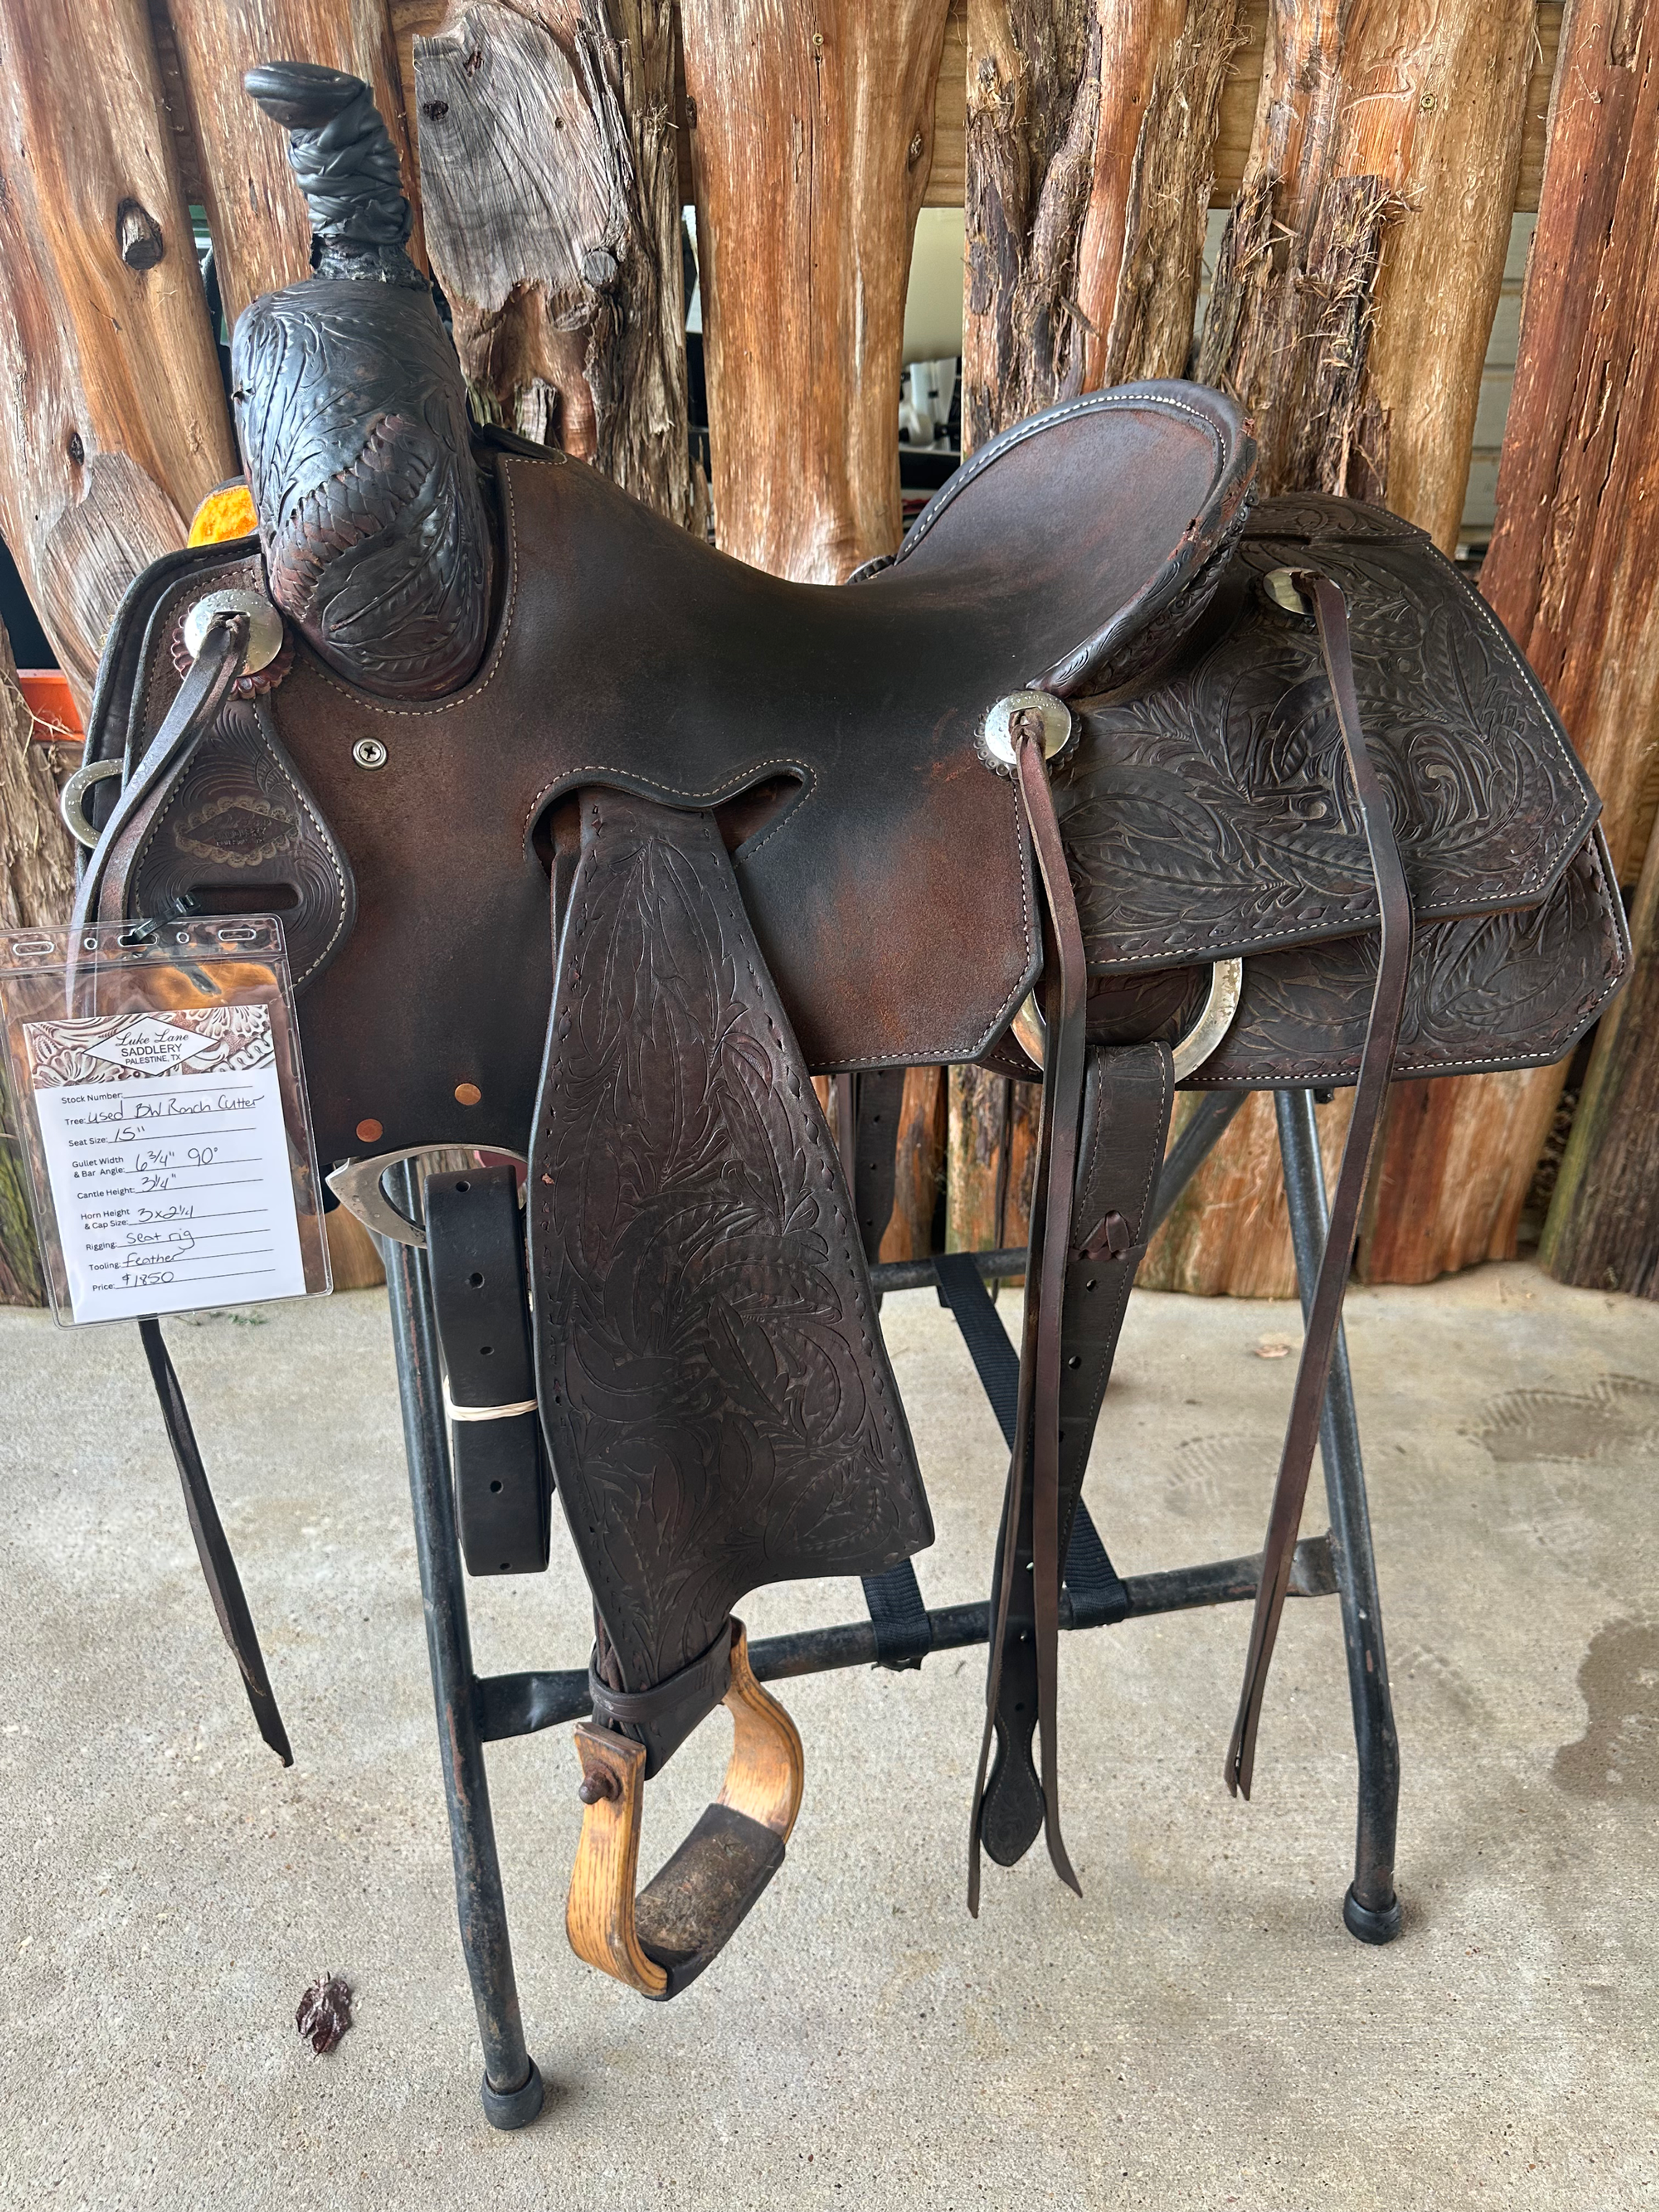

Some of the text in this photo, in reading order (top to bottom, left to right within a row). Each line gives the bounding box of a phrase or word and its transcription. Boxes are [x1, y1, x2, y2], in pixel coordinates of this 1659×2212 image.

[115, 1029, 189, 1046] Luke Lane
[121, 1043, 182, 1057] SADDLERY
[61, 1092, 123, 1104] Stock Number:
[134, 1102, 162, 1119] BW
[218, 1094, 264, 1109] Cutter
[69, 1138, 87, 1147] Seat
[72, 1156, 124, 1168] Gullet Width
[100, 1167, 125, 1176] Angle:
[77, 1190, 105, 1199] Cantle
[106, 1188, 136, 1196] Height:
[103, 1209, 130, 1217] Height
[86, 1242, 117, 1251] Rigging:
[168, 1228, 195, 1250] rig
[89, 1261, 121, 1271] Tooling:
[122, 1271, 174, 1288] $1850
